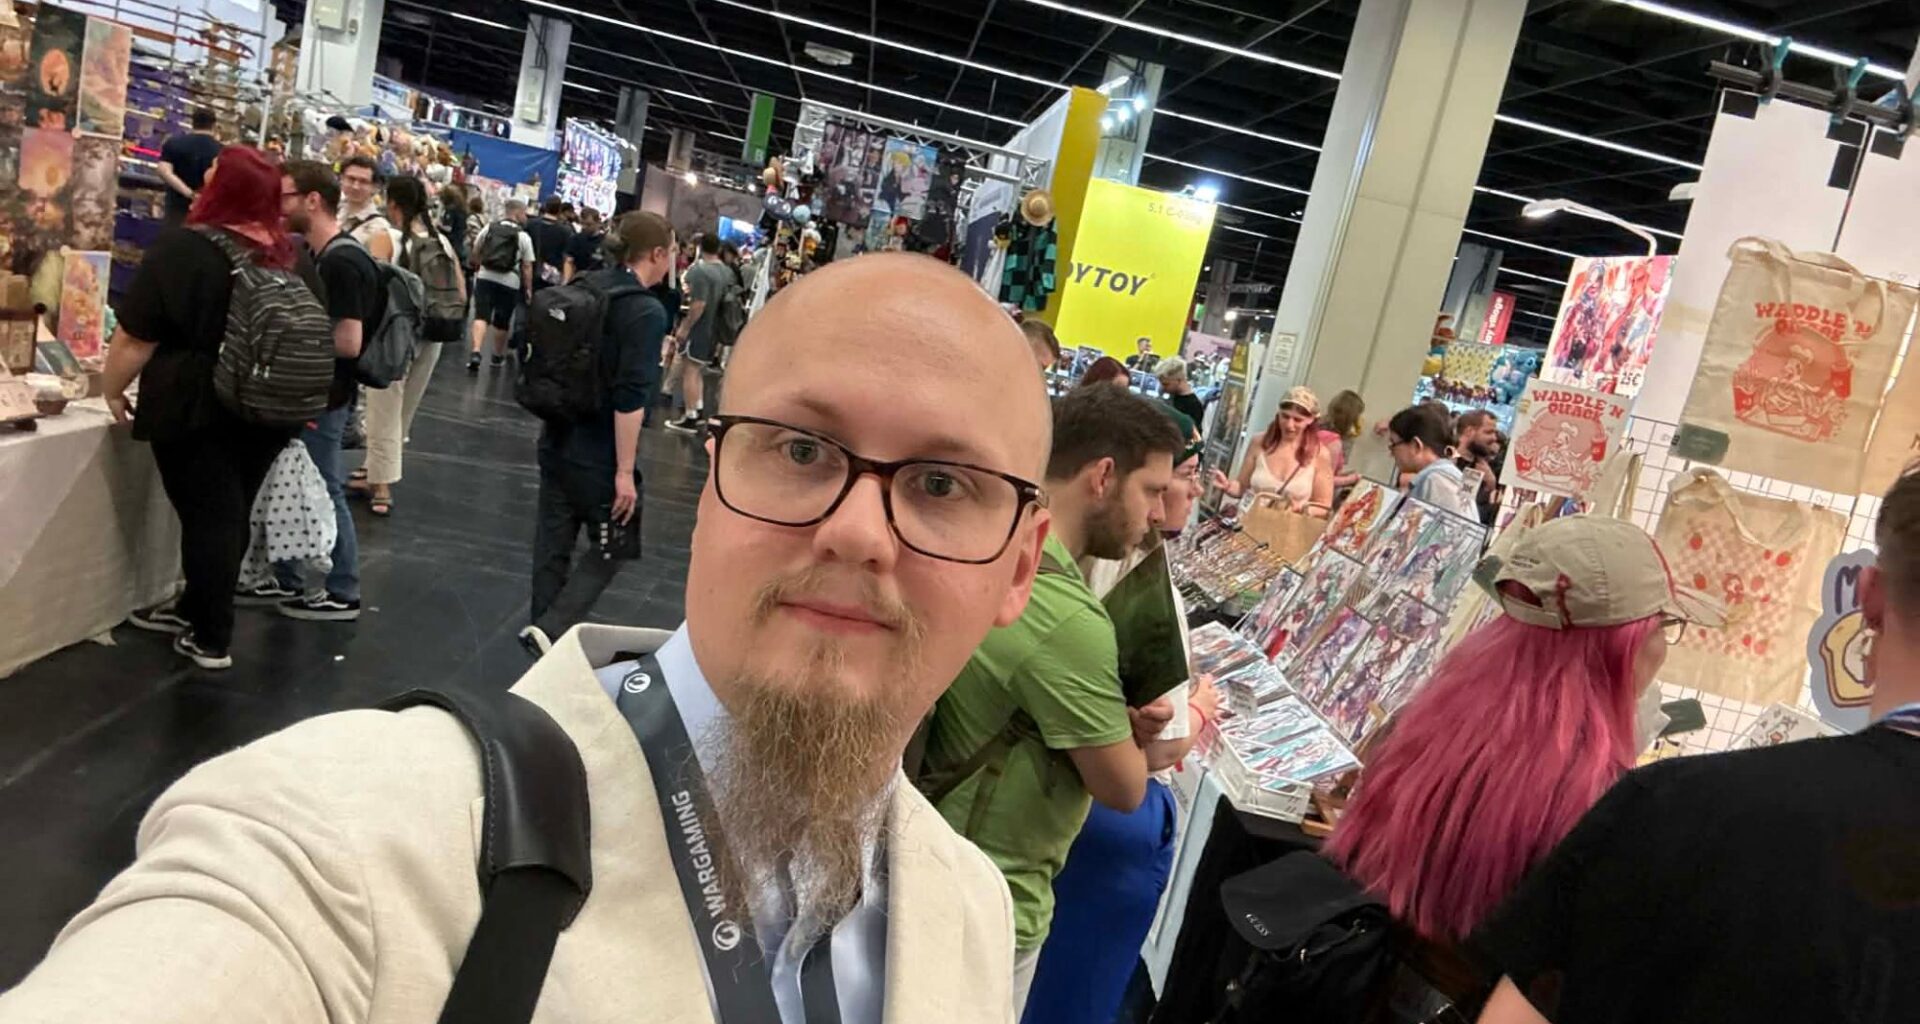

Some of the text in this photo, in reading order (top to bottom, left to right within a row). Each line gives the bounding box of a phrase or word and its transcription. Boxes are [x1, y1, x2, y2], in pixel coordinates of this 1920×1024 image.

[1069, 260, 1149, 297] YTOY
[1754, 301, 1847, 330] WADDLE
[1532, 390, 1607, 411] WADDLE
[1548, 402, 1603, 423] QUACK
[671, 789, 727, 918] WARGAMING
